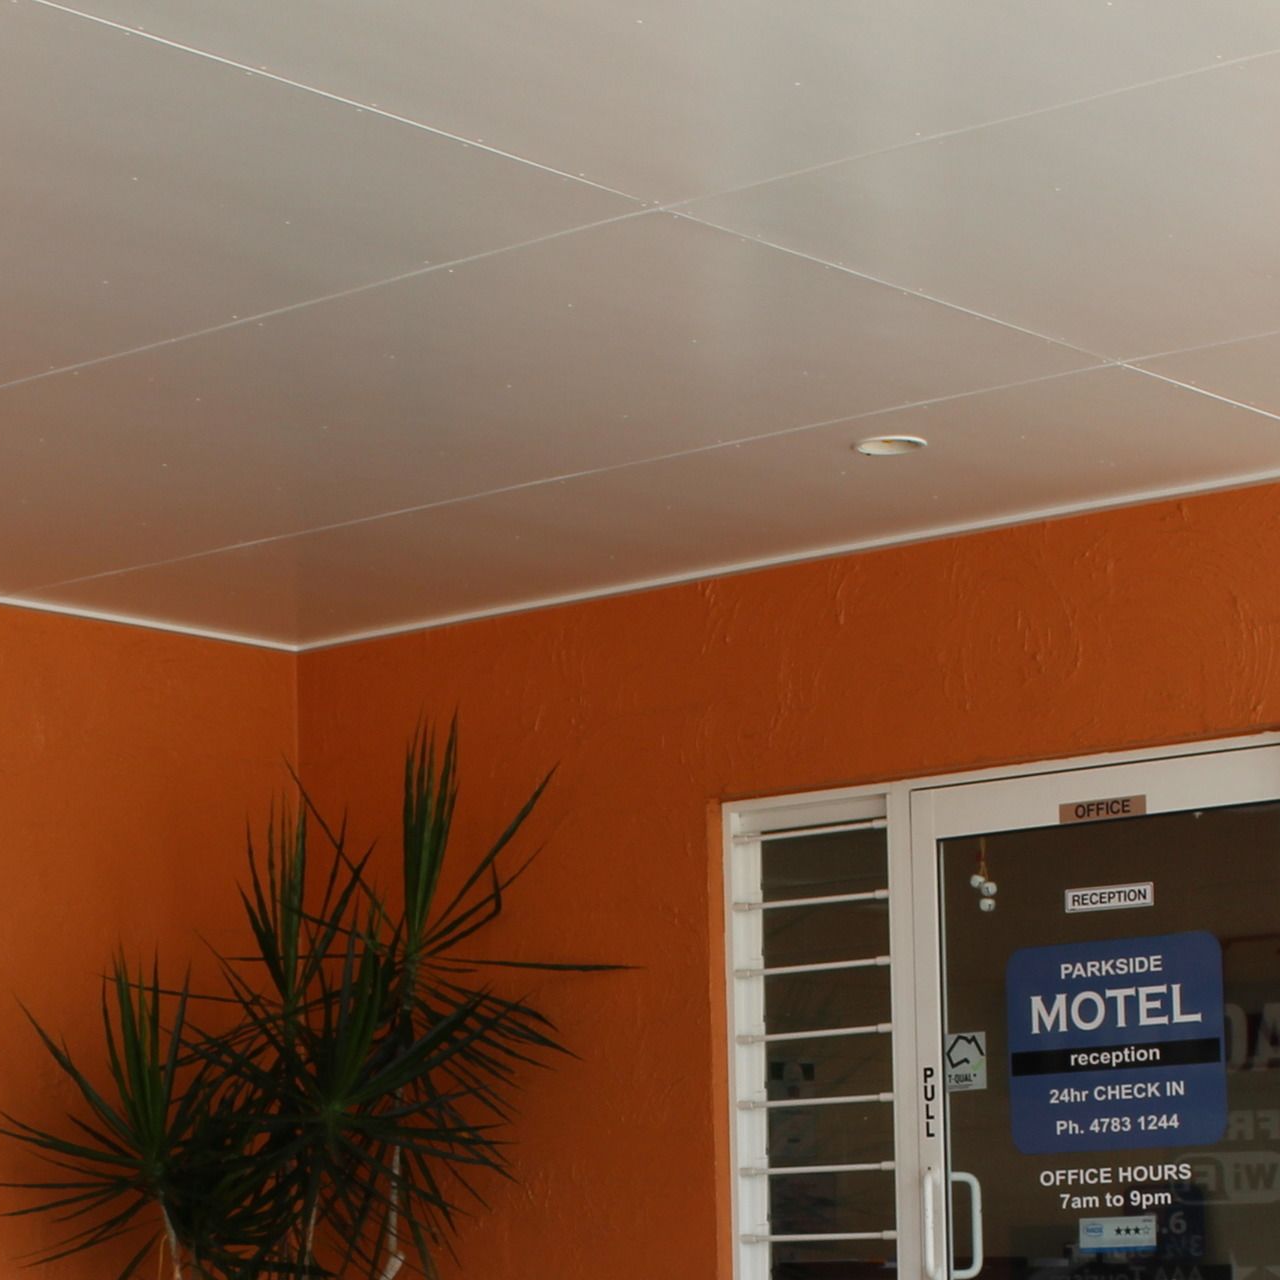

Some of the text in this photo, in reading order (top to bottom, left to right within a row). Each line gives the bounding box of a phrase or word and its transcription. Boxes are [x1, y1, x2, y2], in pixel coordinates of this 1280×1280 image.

[1074, 799, 1132, 819] OFFICE
[1071, 888, 1148, 908] RECEPTION
[1060, 955, 1163, 980] PARKSIDE
[1030, 983, 1202, 1035] MOTEL
[1069, 1046, 1161, 1067] reception
[923, 1067, 936, 1138] PULL
[1049, 1080, 1185, 1104] 24hr CHECK IN
[1055, 1113, 1180, 1136] Ph. 4783 1244
[1039, 1163, 1192, 1187] OFFICE HOURS
[1059, 1190, 1172, 1210] 7am to 9pm
